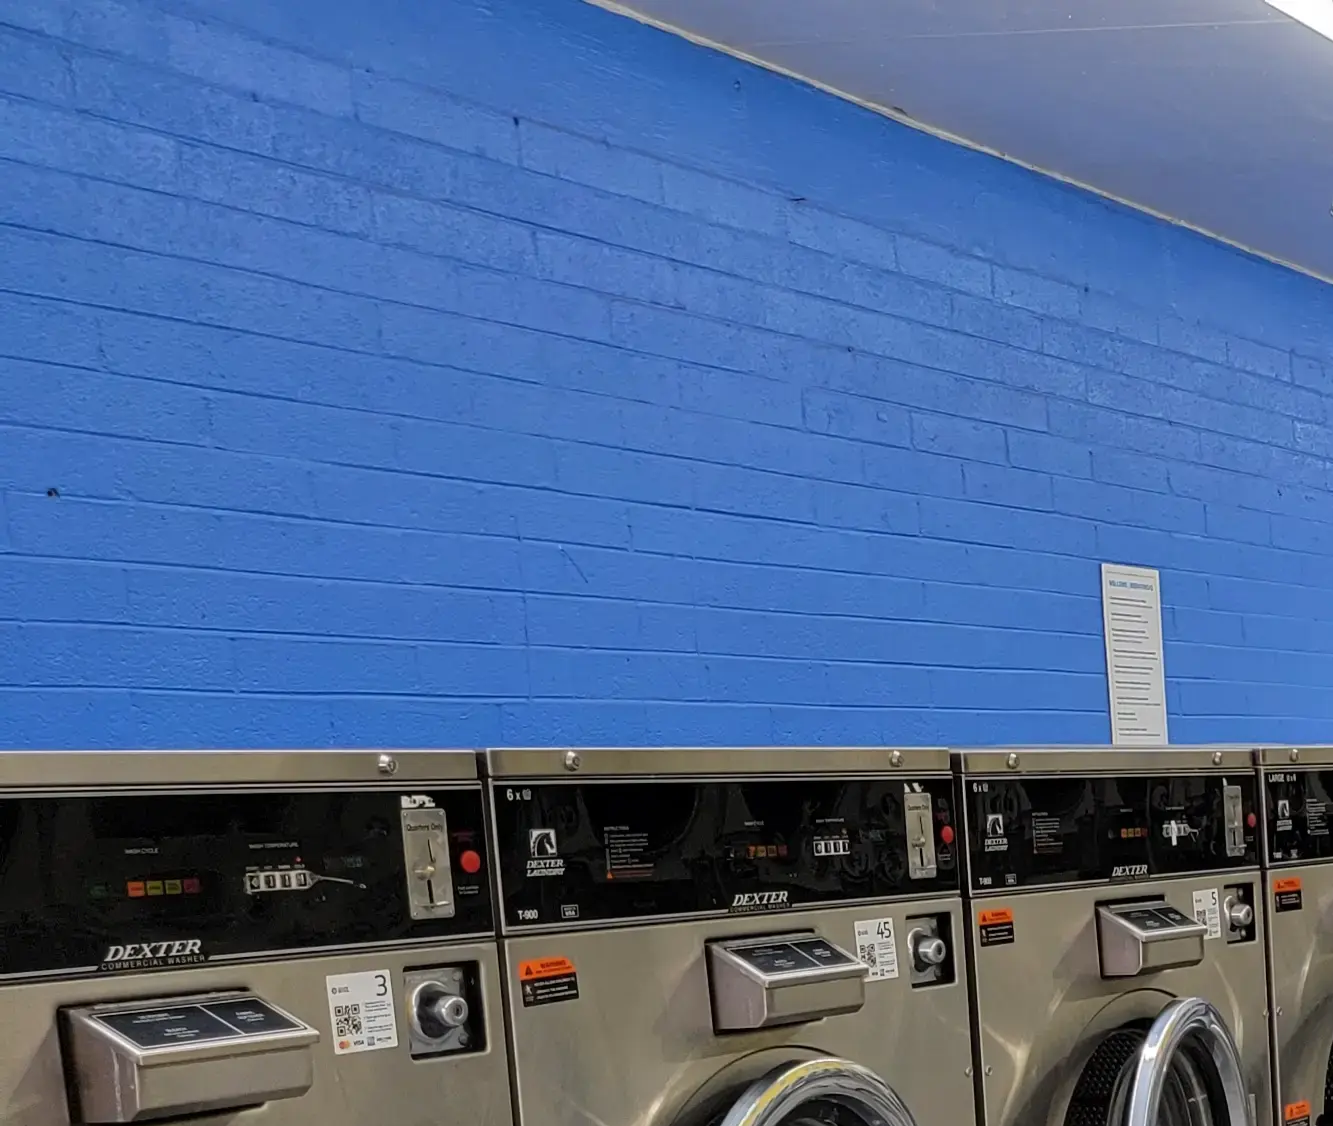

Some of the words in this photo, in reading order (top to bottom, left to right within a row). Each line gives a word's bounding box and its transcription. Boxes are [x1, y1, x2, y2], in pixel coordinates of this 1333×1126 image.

[973, 782, 977, 793] 6
[506, 789, 514, 801] 6
[406, 823, 430, 832] Quarters
[431, 823, 443, 832] Only
[526, 859, 564, 869] DEXTER
[1112, 864, 1148, 877] DEXTER
[732, 890, 788, 907] DEXTER
[1211, 891, 1217, 906] 5
[518, 909, 538, 920] T-900
[876, 921, 892, 939] 45
[104, 938, 202, 962] DEXTER
[101, 958, 163, 971] COMMERCIAL
[168, 954, 205, 965] WASHER
[374, 974, 388, 996] 3
